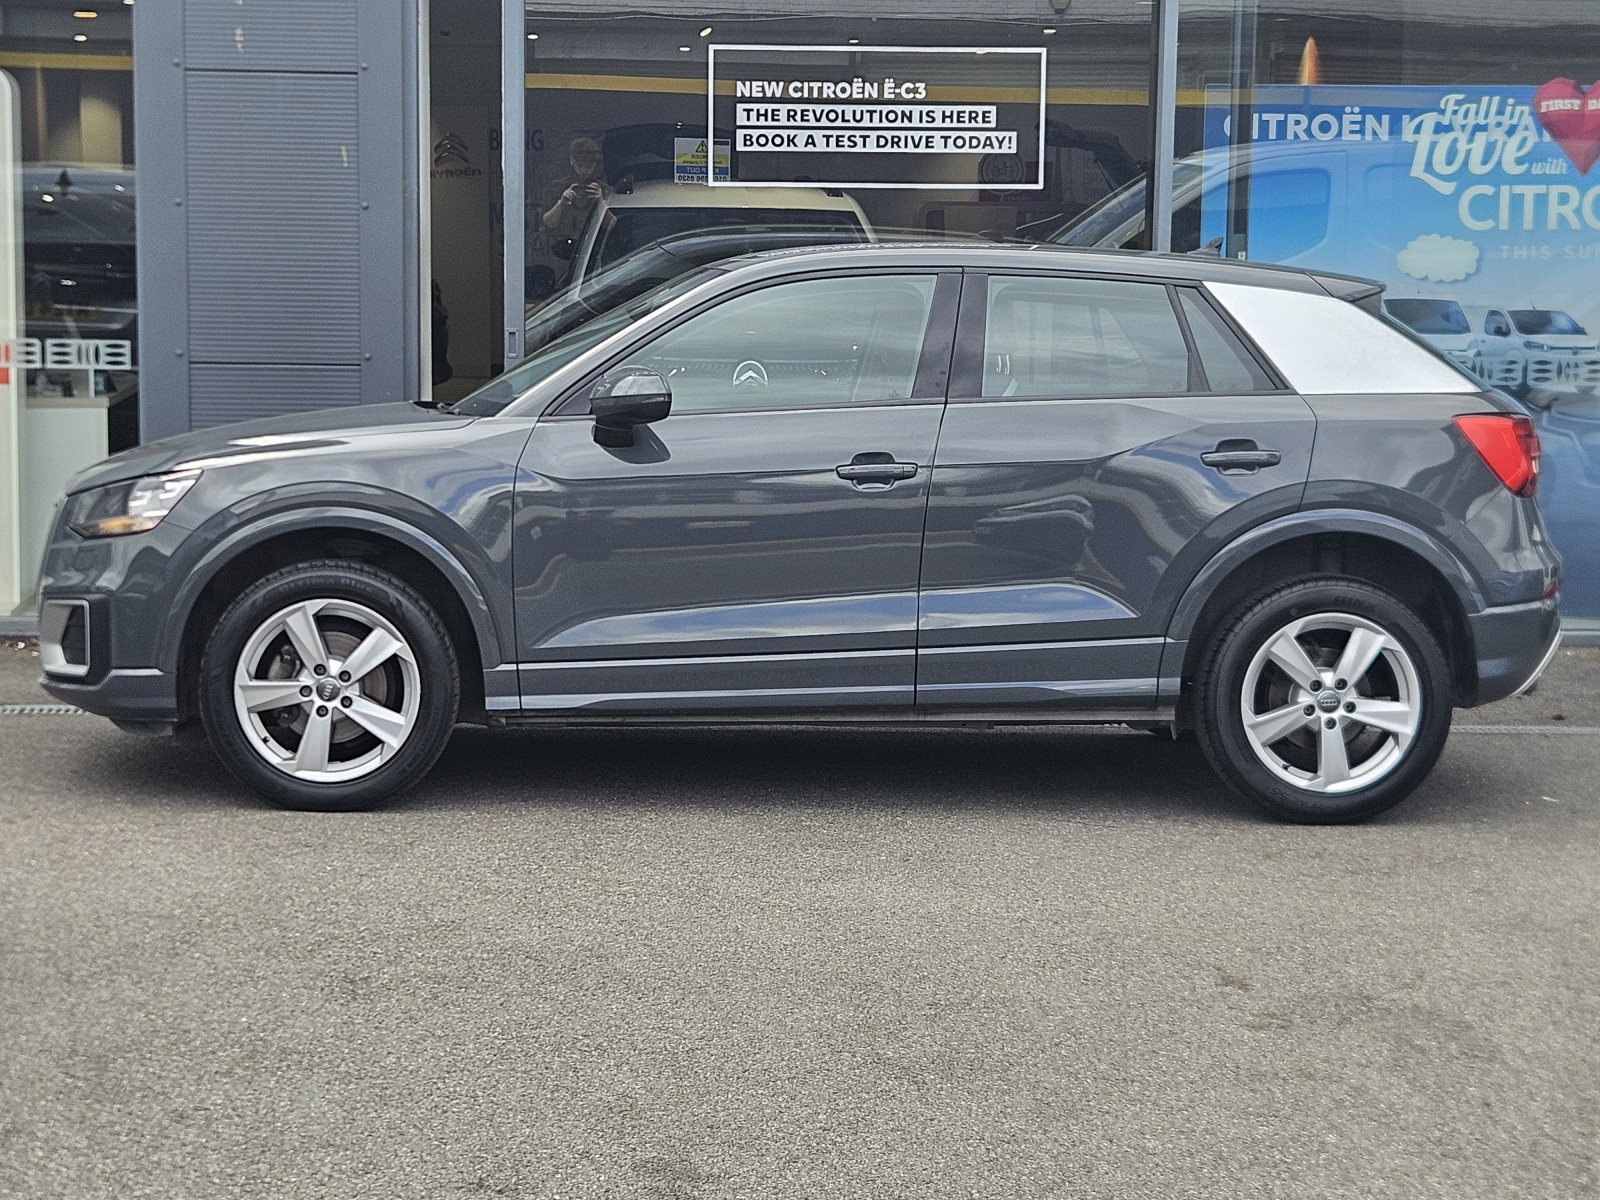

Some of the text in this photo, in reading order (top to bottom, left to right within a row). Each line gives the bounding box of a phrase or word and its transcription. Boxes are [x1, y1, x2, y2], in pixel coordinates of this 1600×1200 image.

[736, 77, 927, 100] NEW CITROËN Ë-C3
[1439, 93, 1530, 126] Fall in
[1540, 98, 1581, 113] FIRST
[743, 108, 992, 125] THE REVOLUTION IS HERE
[743, 133, 1013, 150] BOOK A TEST DRIVE TODAY!
[1405, 111, 1537, 196] Love
[1531, 158, 1568, 175] with
[1499, 244, 1551, 260] THIS
